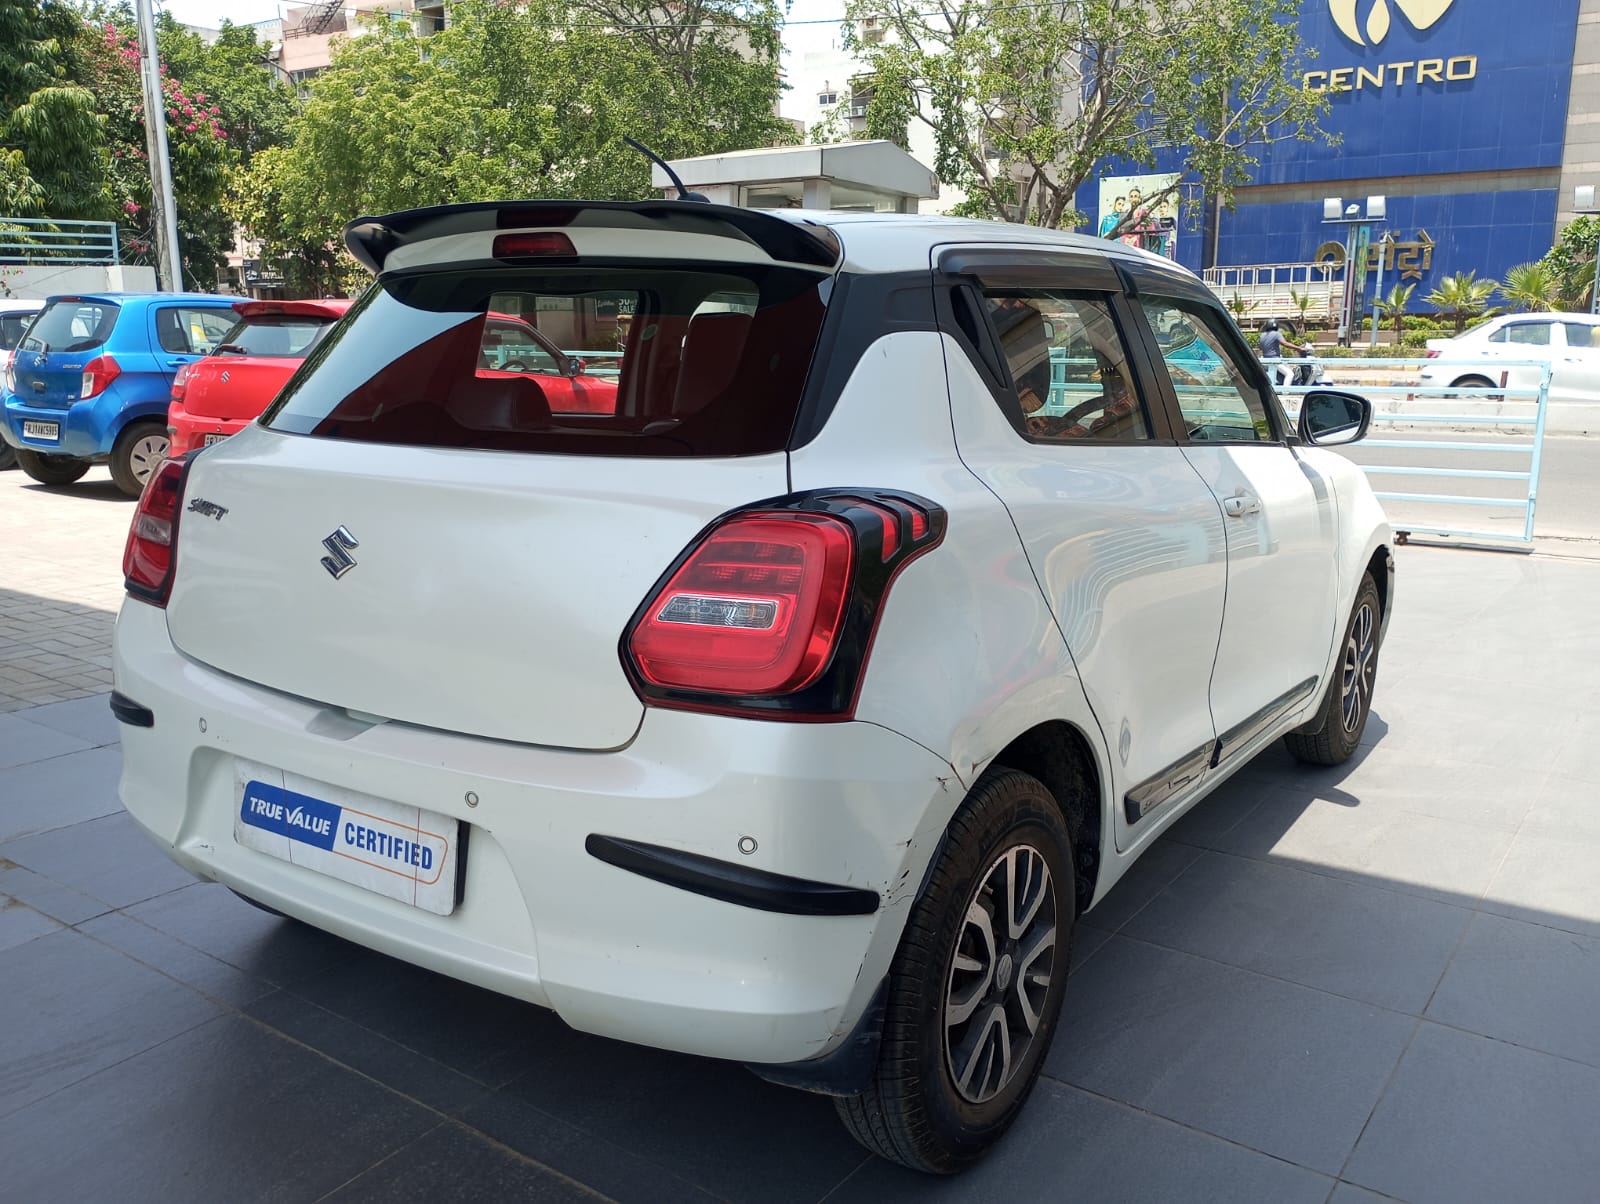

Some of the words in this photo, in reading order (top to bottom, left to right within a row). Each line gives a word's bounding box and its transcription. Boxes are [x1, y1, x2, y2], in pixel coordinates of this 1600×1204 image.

[1302, 55, 1478, 93] CENTRO
[250, 797, 283, 821] TRUE
[285, 806, 332, 836] VALUE
[345, 822, 433, 870] CERTIFIED
